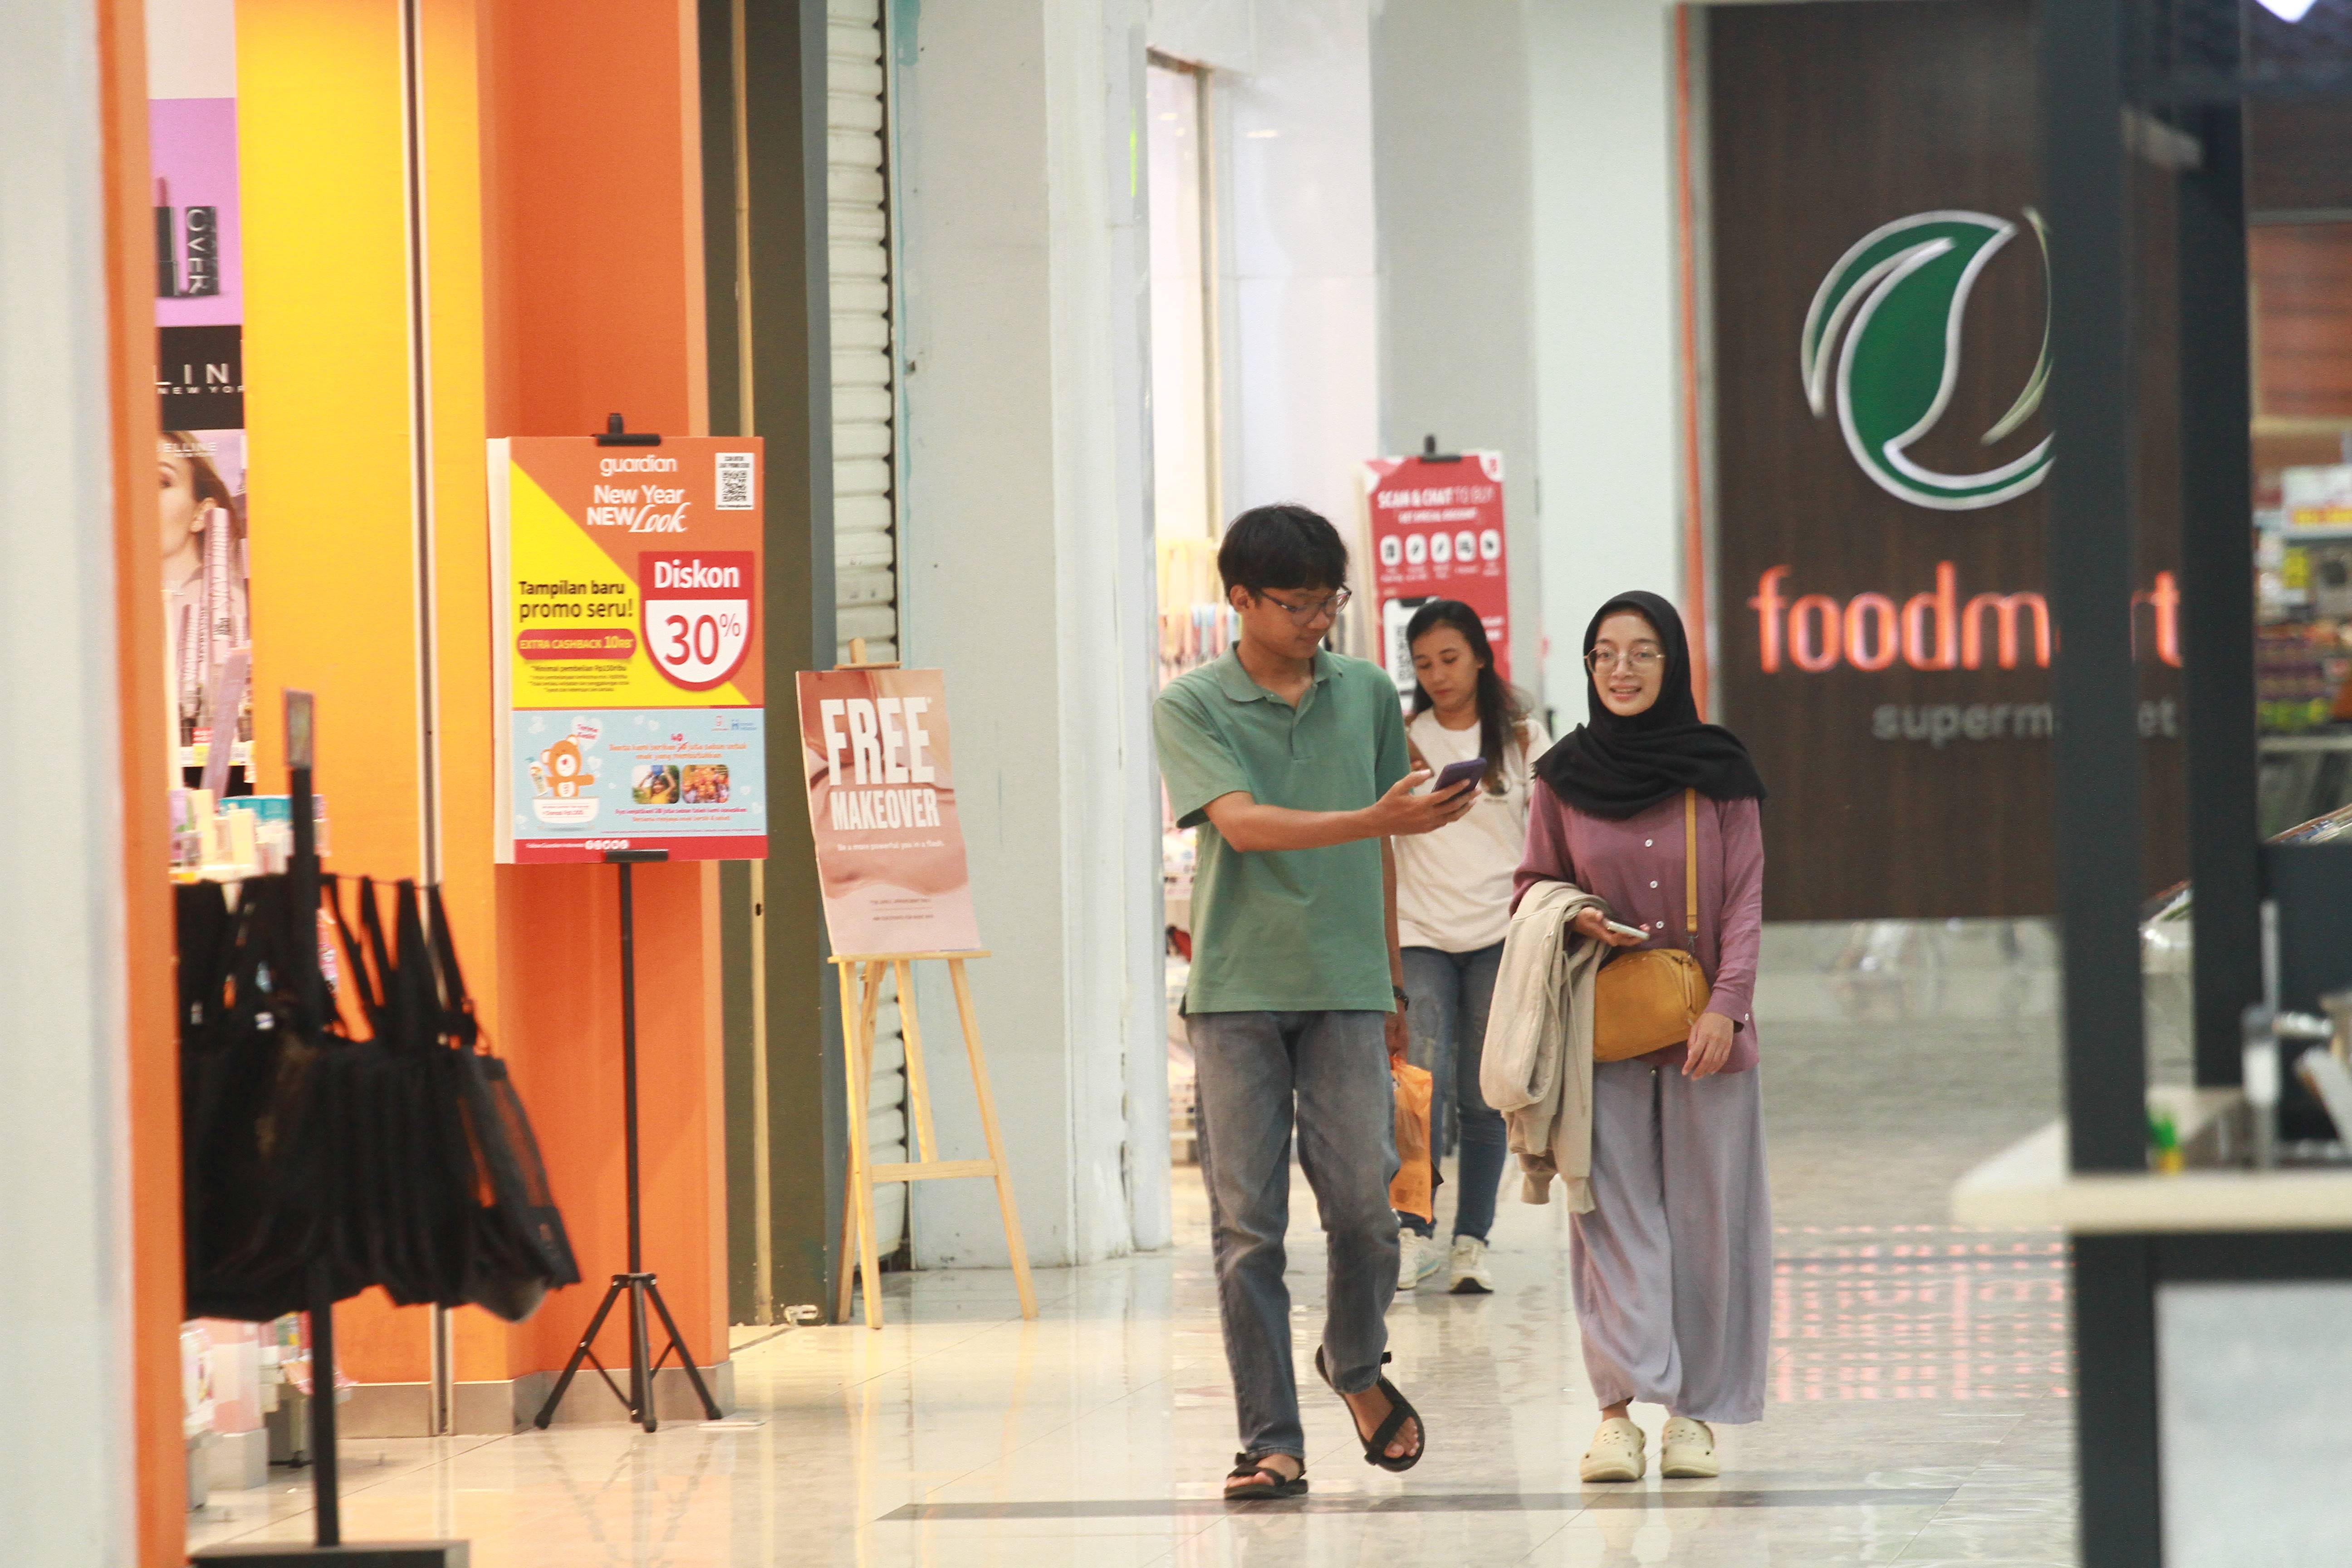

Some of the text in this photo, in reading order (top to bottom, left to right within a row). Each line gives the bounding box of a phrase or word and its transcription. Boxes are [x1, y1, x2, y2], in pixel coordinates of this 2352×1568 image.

[187, 209, 210, 294] OVER
[600, 455, 677, 477] guardian
[594, 485, 685, 505] New Year
[1377, 490, 1410, 510] SCAN
[1422, 487, 1453, 506] CHAT
[587, 502, 691, 533] NEW Look
[519, 580, 624, 598] Tampilan baru
[655, 559, 740, 589] Diskon
[519, 599, 632, 622] promo seru!
[1748, 560, 2183, 675] foodmt
[519, 639, 550, 649] EXTRA
[552, 639, 602, 649] CASHBACK
[664, 613, 741, 666] 30%
[1872, 698, 2177, 749] supermet
[820, 696, 935, 786] FREE
[830, 789, 941, 831] MAKEOVER
